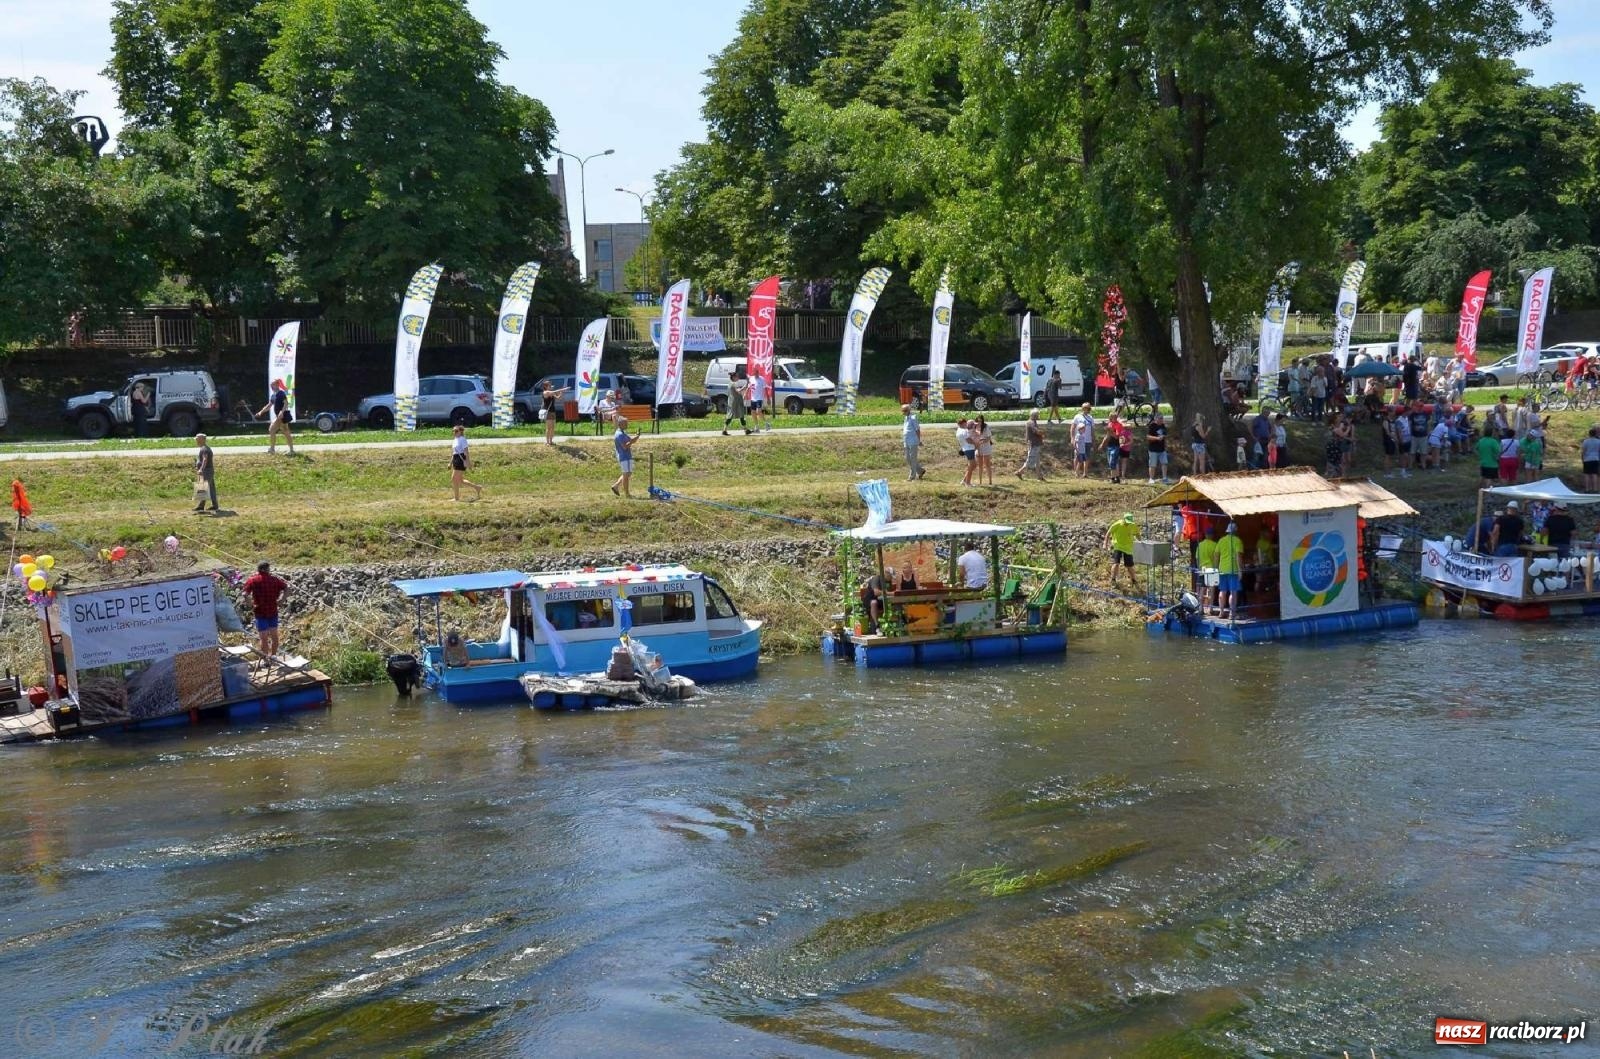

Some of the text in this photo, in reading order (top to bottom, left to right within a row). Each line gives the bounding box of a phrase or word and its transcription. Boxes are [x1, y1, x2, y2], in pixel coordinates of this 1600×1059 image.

[1525, 279, 1544, 351] RACIBÓRZ
[545, 591, 572, 601] MIEJSCE
[632, 582, 685, 594] GMINA CISEK
[74, 598, 125, 623] SKLEP
[130, 594, 150, 615] PE
[155, 589, 182, 612] GIE
[185, 585, 210, 607] GIE
